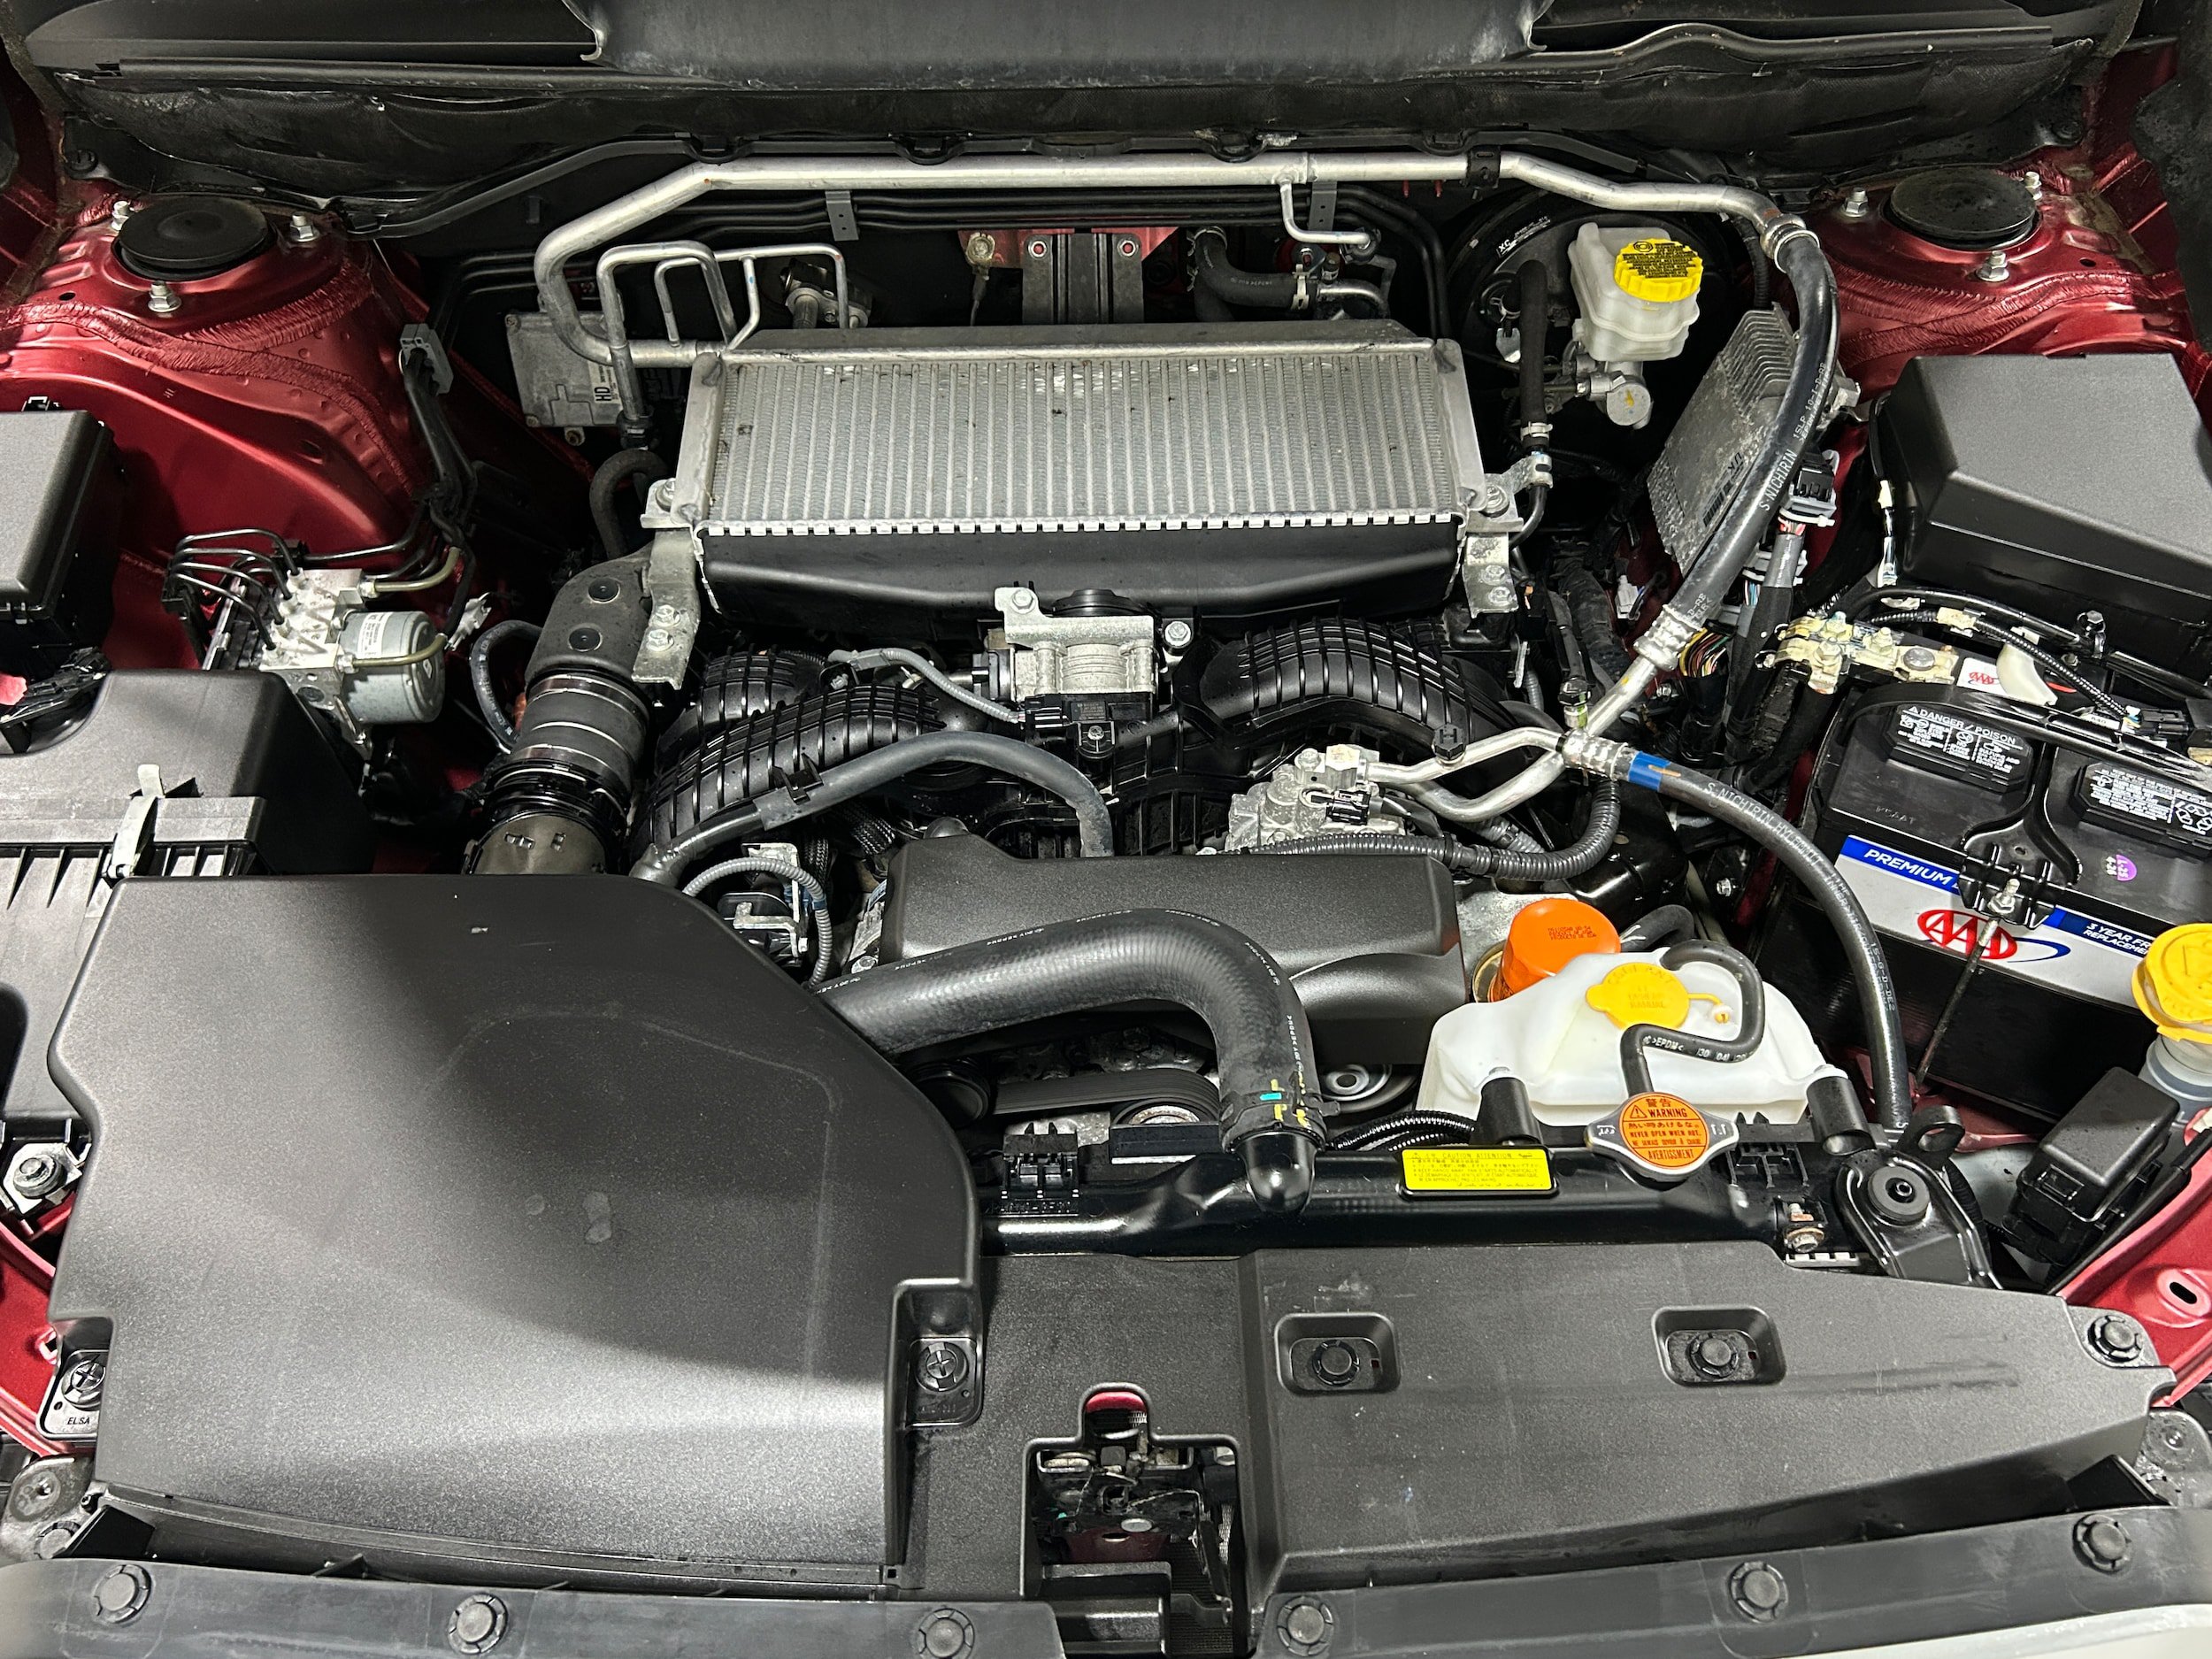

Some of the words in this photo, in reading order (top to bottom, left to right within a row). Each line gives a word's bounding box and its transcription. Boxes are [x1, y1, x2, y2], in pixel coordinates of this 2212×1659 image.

[594, 387, 611, 401] HD
[1727, 452, 1743, 475] UK
[1919, 709, 1964, 729] DANGER
[1974, 726, 2016, 745] POISON
[1863, 849, 1954, 886] PREMIUM
[1917, 909, 2018, 960] AAA
[2098, 926, 2131, 941] YEAR
[1645, 1098, 1671, 1108] 警告
[1648, 1109, 1688, 1119] WARNING
